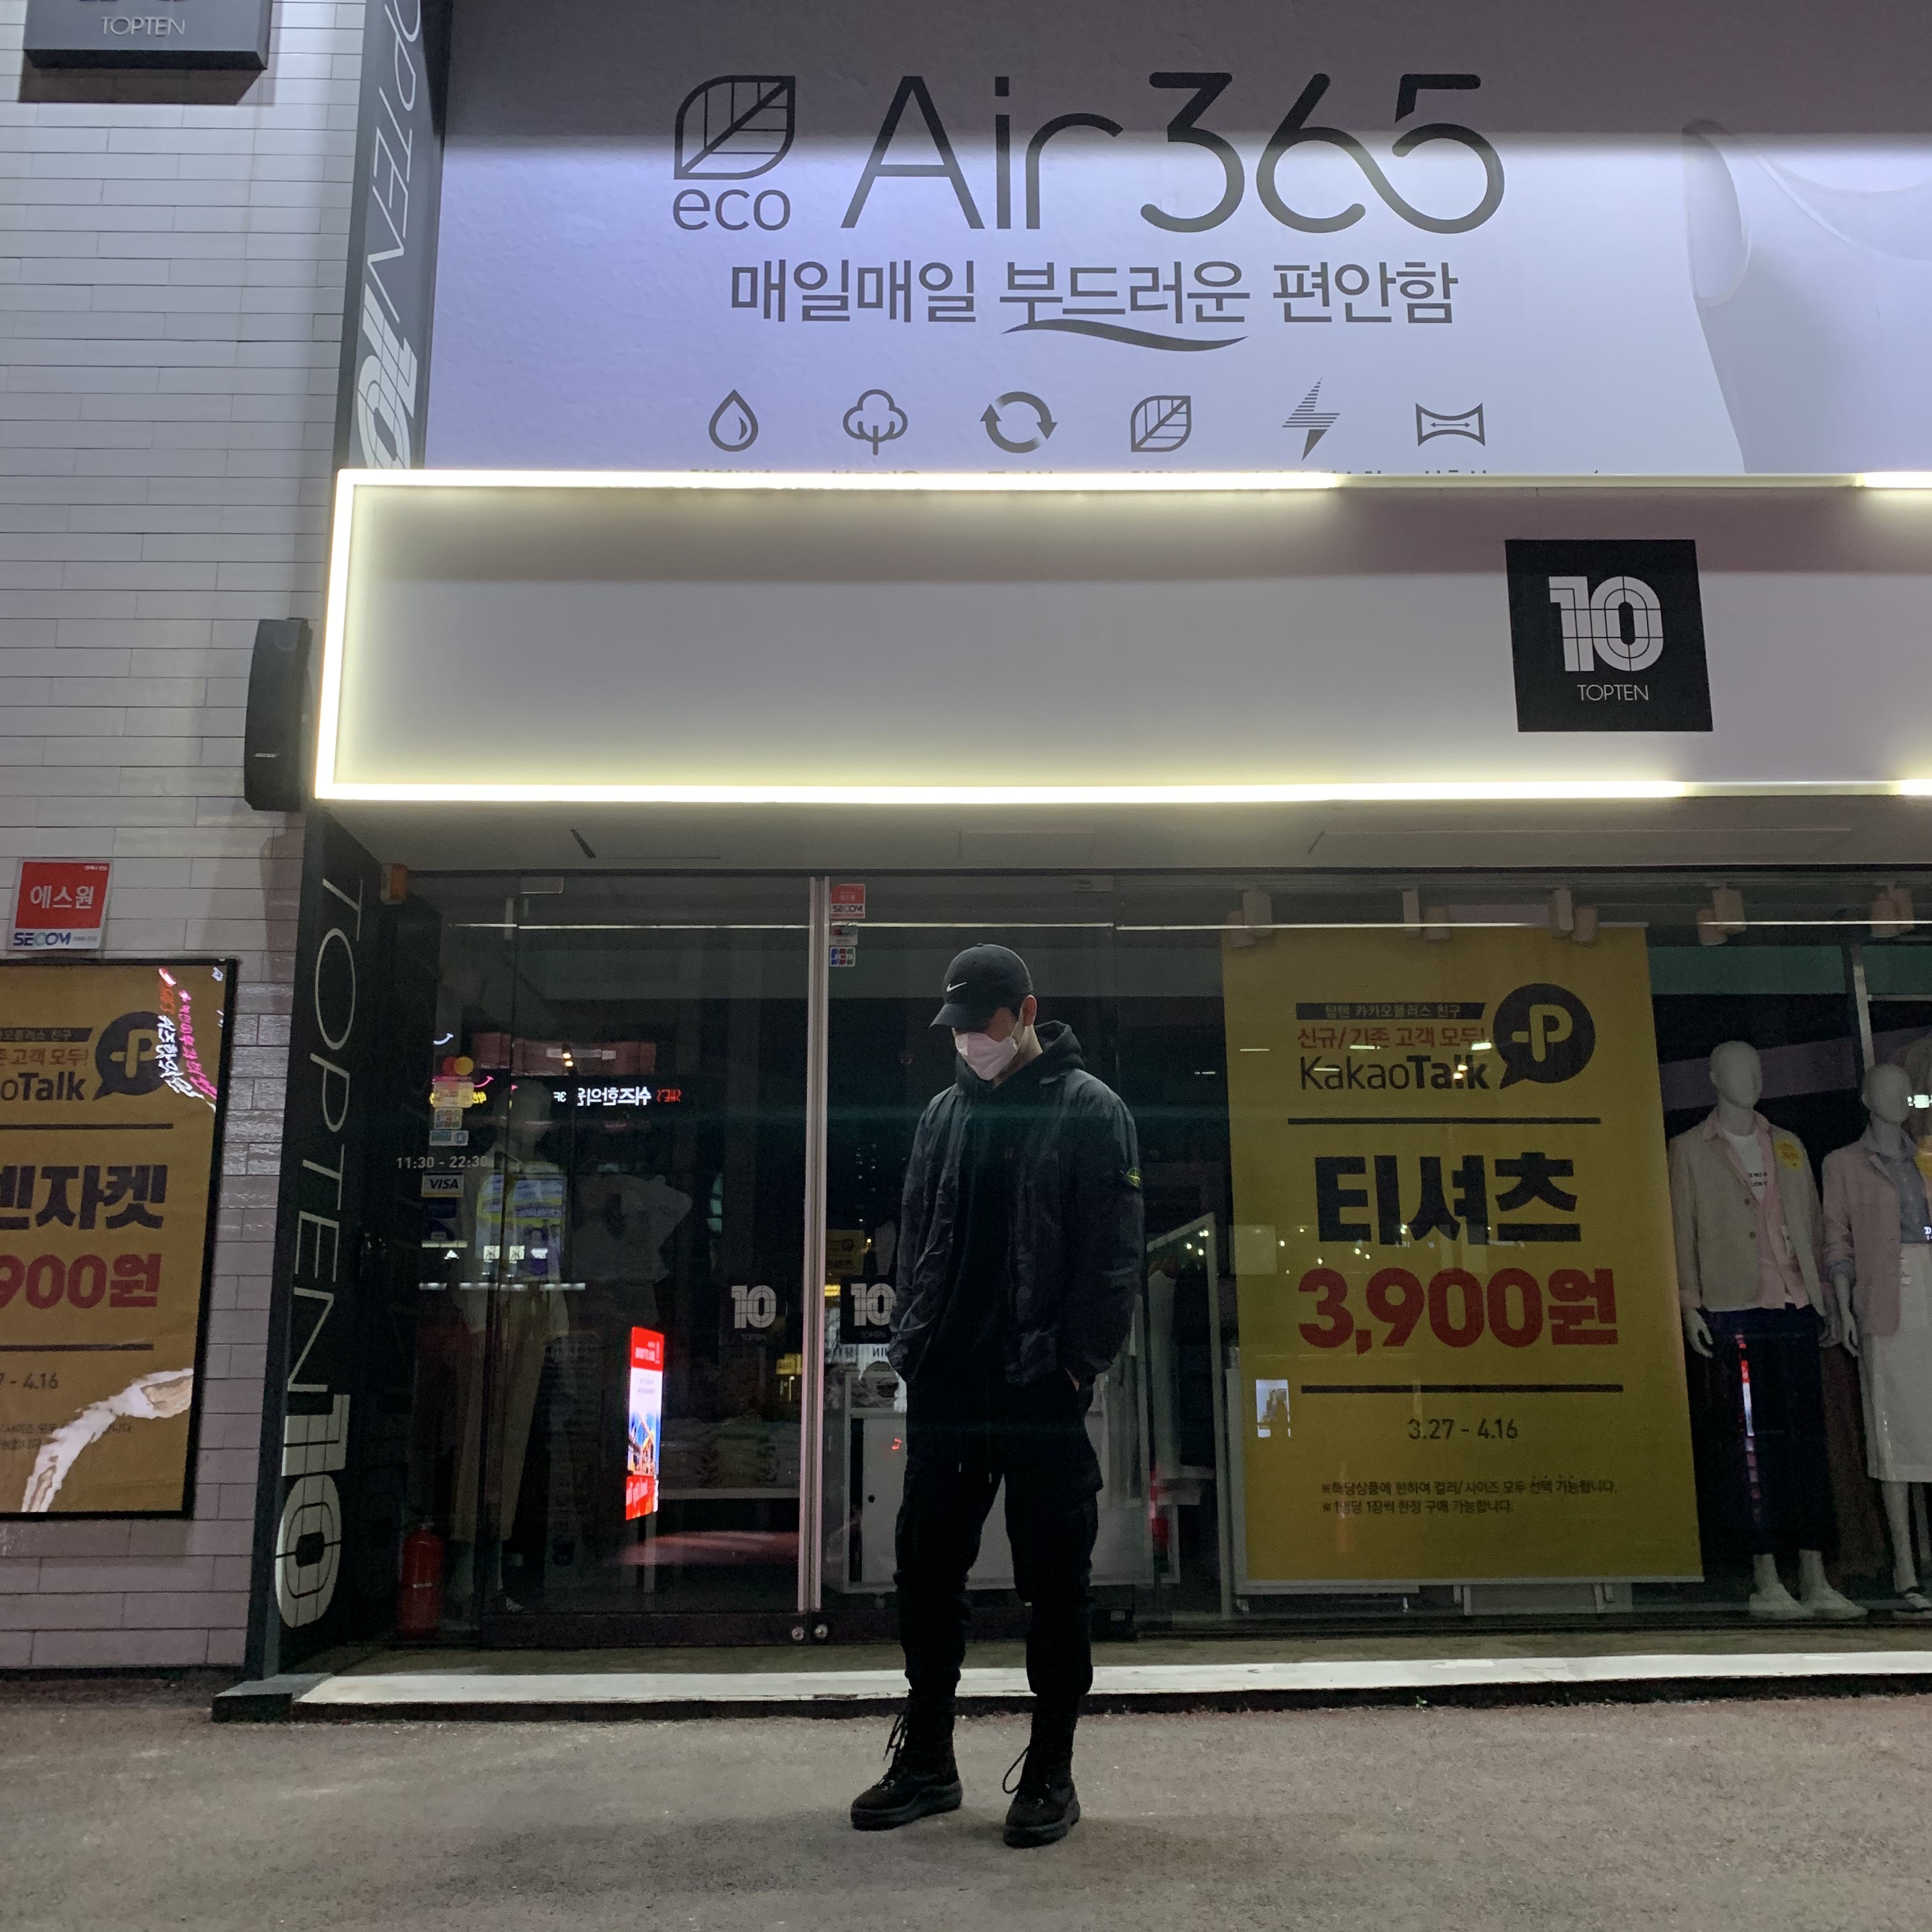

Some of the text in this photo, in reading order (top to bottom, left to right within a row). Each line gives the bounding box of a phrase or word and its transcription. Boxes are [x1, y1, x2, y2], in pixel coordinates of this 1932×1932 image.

[101, 17, 185, 36] TOPTEN
[672, 189, 792, 231] eco
[731, 260, 1459, 325] 매일매일 부드러운 편안함
[1548, 575, 1664, 672] 10
[1577, 684, 1650, 701] TOPTEN
[30, 885, 95, 910] 에스원
[13, 932, 72, 947] SECOM
[1436, 1004, 1462, 1018] 친구
[1395, 1026, 1436, 1048] 고객
[12, 1048, 46, 1066] 고객
[49, 1048, 89, 1066] 모두!
[1300, 1055, 1490, 1090] KakaoTalk
[286, 878, 364, 1393] TOPTEN
[396, 1156, 435, 1169] 11:30
[449, 1156, 488, 1169] 22:30
[429, 1178, 459, 1190] VISA
[1315, 1152, 1582, 1245] 티셔츠
[732, 1285, 777, 1329] 10
[850, 1283, 895, 1326] 10
[1298, 1267, 1619, 1355] 3,900원
[24, 1372, 59, 1390] 4.16
[1407, 1420, 1454, 1440] 3.27
[1477, 1419, 1519, 1439] 4.16
[276, 1394, 351, 1629] 10
